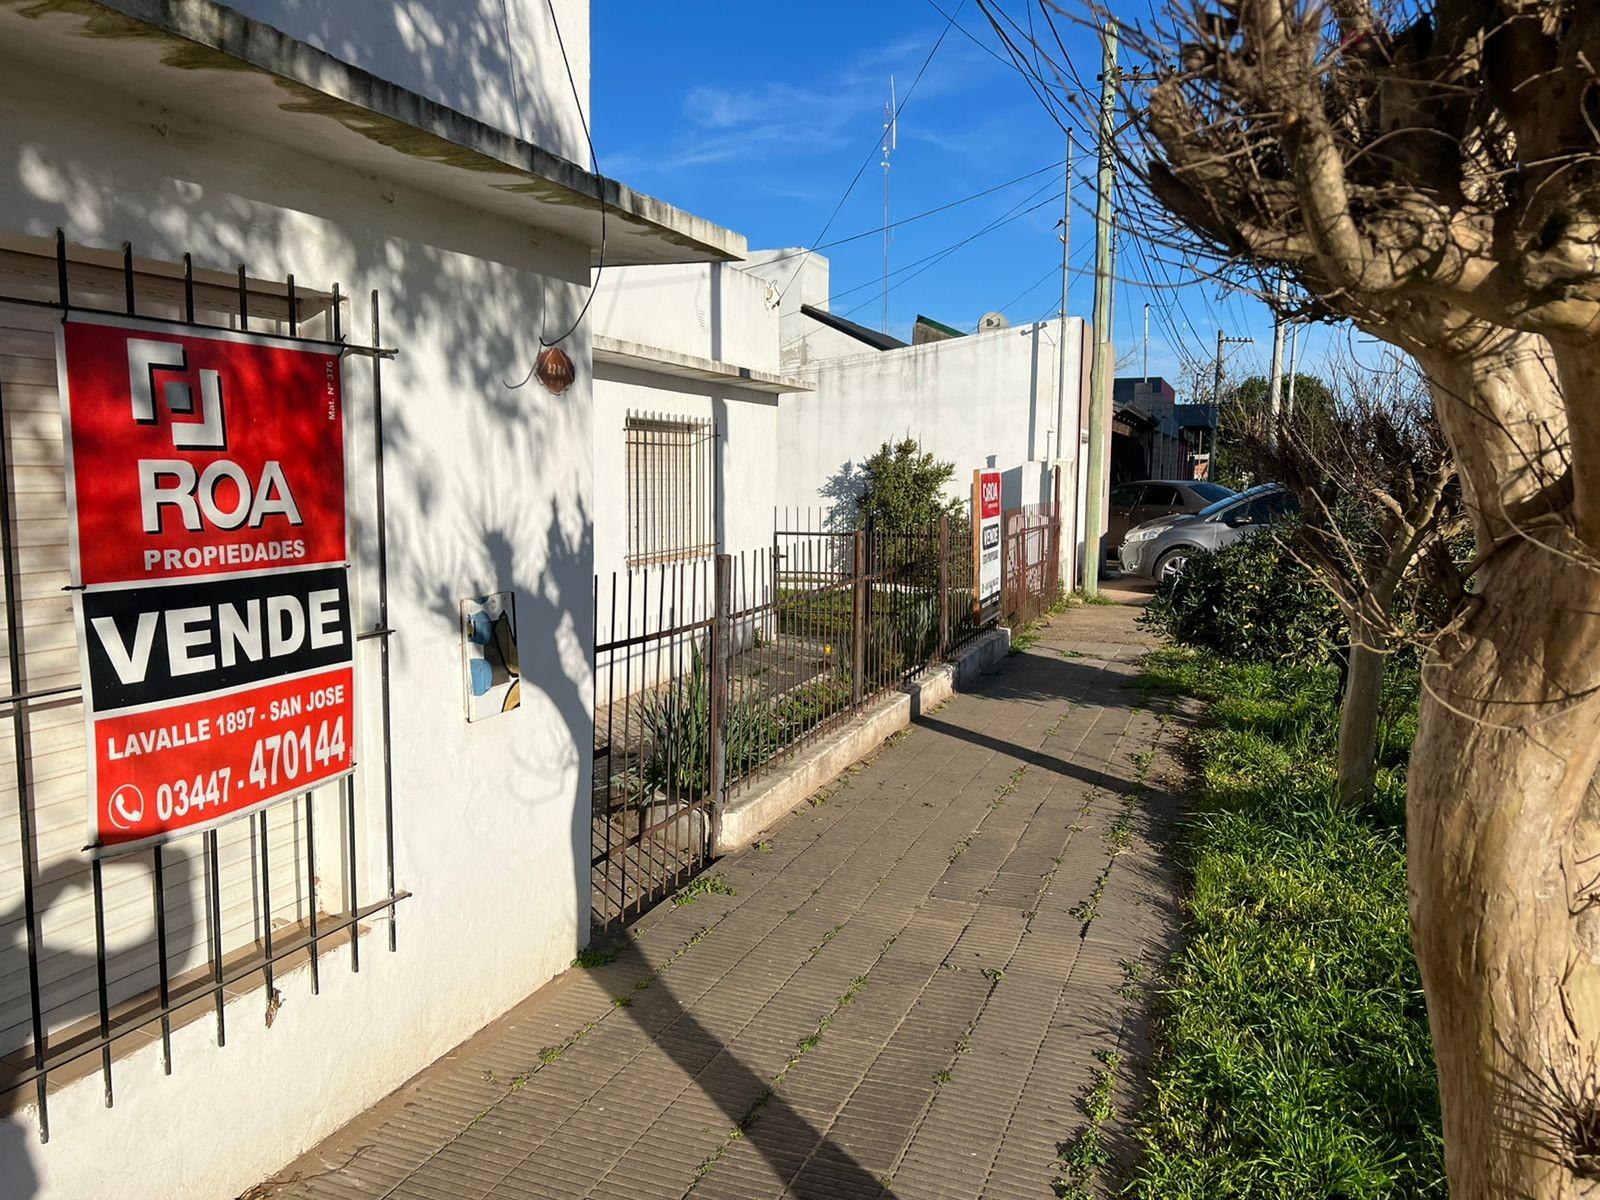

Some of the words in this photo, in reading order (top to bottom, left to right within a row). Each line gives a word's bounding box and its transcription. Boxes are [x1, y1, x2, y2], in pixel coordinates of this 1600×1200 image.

[326, 361, 334, 380] 376
[328, 398, 336, 421] Mat.
[137, 459, 303, 533] ROA
[143, 539, 306, 571] PROPIEDADES
[984, 527, 999, 546] VENDE
[90, 588, 344, 685] VENDE
[107, 719, 211, 761] LAVALLE
[215, 706, 256, 736] 1897
[270, 694, 302, 722] SAN
[306, 684, 345, 712] JOSE
[156, 767, 232, 821] 03447
[249, 715, 346, 790] 470144
